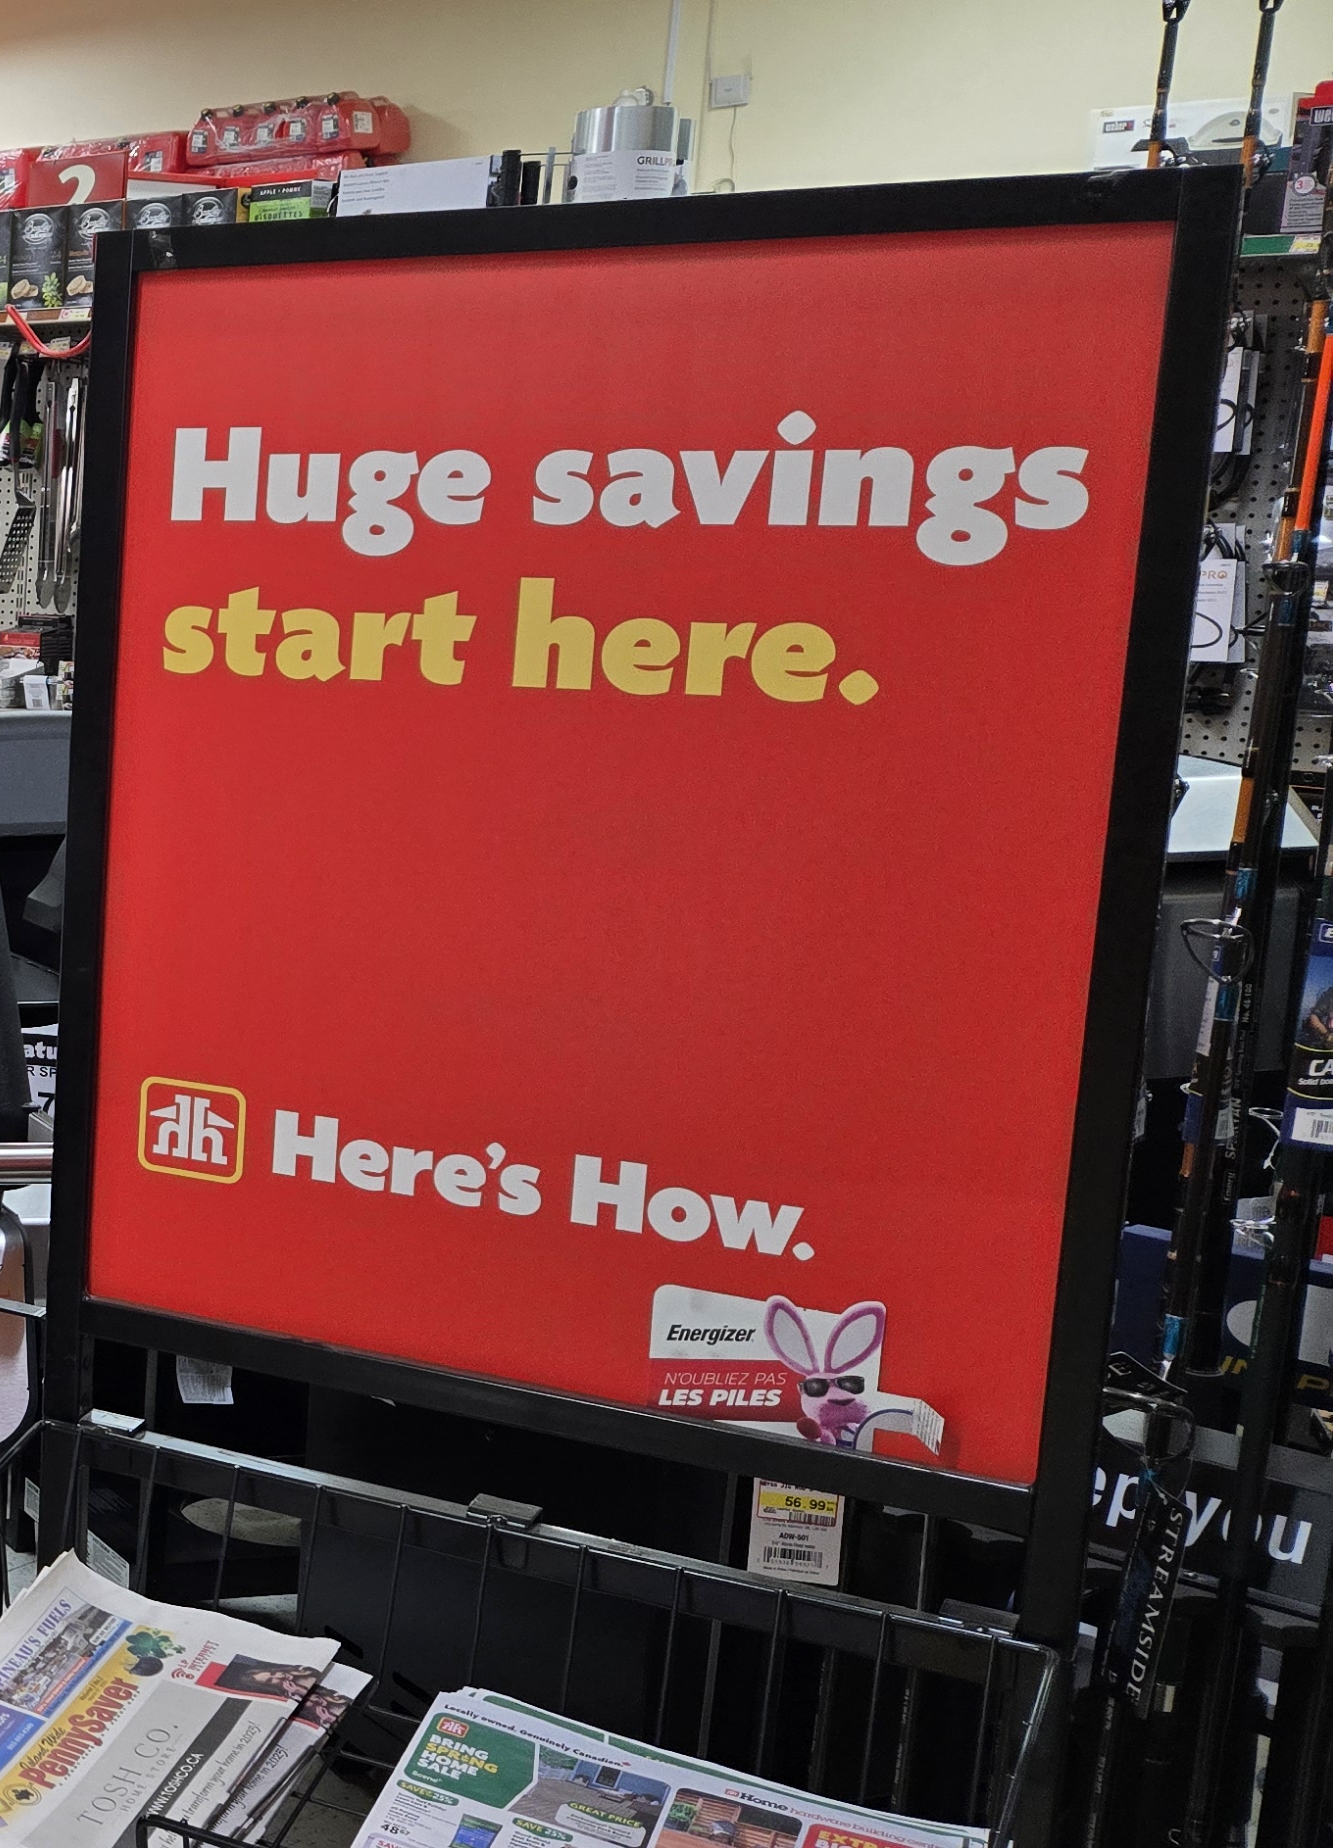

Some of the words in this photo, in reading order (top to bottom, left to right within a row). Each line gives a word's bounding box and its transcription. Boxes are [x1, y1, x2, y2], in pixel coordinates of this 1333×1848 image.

[58, 164, 96, 206] 2
[259, 188, 276, 196] APPLE
[169, 426, 492, 557] Huge
[532, 410, 1090, 567] savings
[162, 585, 478, 683] start
[511, 576, 880, 706] here.
[570, 1153, 816, 1262] How.
[665, 1324, 756, 1346] Energizer
[664, 1371, 749, 1386] N'OUBLIEZ
[754, 1372, 788, 1386] PAS
[658, 1388, 704, 1407] LES
[708, 1388, 783, 1407] PILES
[778, 1532, 810, 1541] ADW-501
[36, 1598, 73, 1639] FUELS
[1125, 1507, 1184, 1707] STREAMSIDE
[187, 1638, 220, 1673] INTERNET
[18, 1676, 139, 1790] PennySaver
[134, 1723, 179, 1760] CO.
[444, 1703, 480, 1721] Locally
[480, 1716, 518, 1733] owned.
[519, 1728, 572, 1753] Genuinely
[146, 1745, 176, 1780] STORE
[420, 1751, 479, 1777] HOME
[425, 1743, 499, 1774] SPRING
[429, 1734, 489, 1761] BRING
[416, 1758, 463, 1781] SALE
[76, 1765, 142, 1826] TOSH
[118, 1782, 148, 1814] HOME
[379, 1823, 400, 1836] 48
[514, 1818, 543, 1834] SAVE
[543, 1827, 567, 1841] 25%
[569, 1801, 607, 1819] GREAT
[608, 1813, 644, 1829] PRICE
[738, 1791, 789, 1813] Home
[789, 1807, 852, 1829] hardware
[851, 1822, 907, 1846] building
